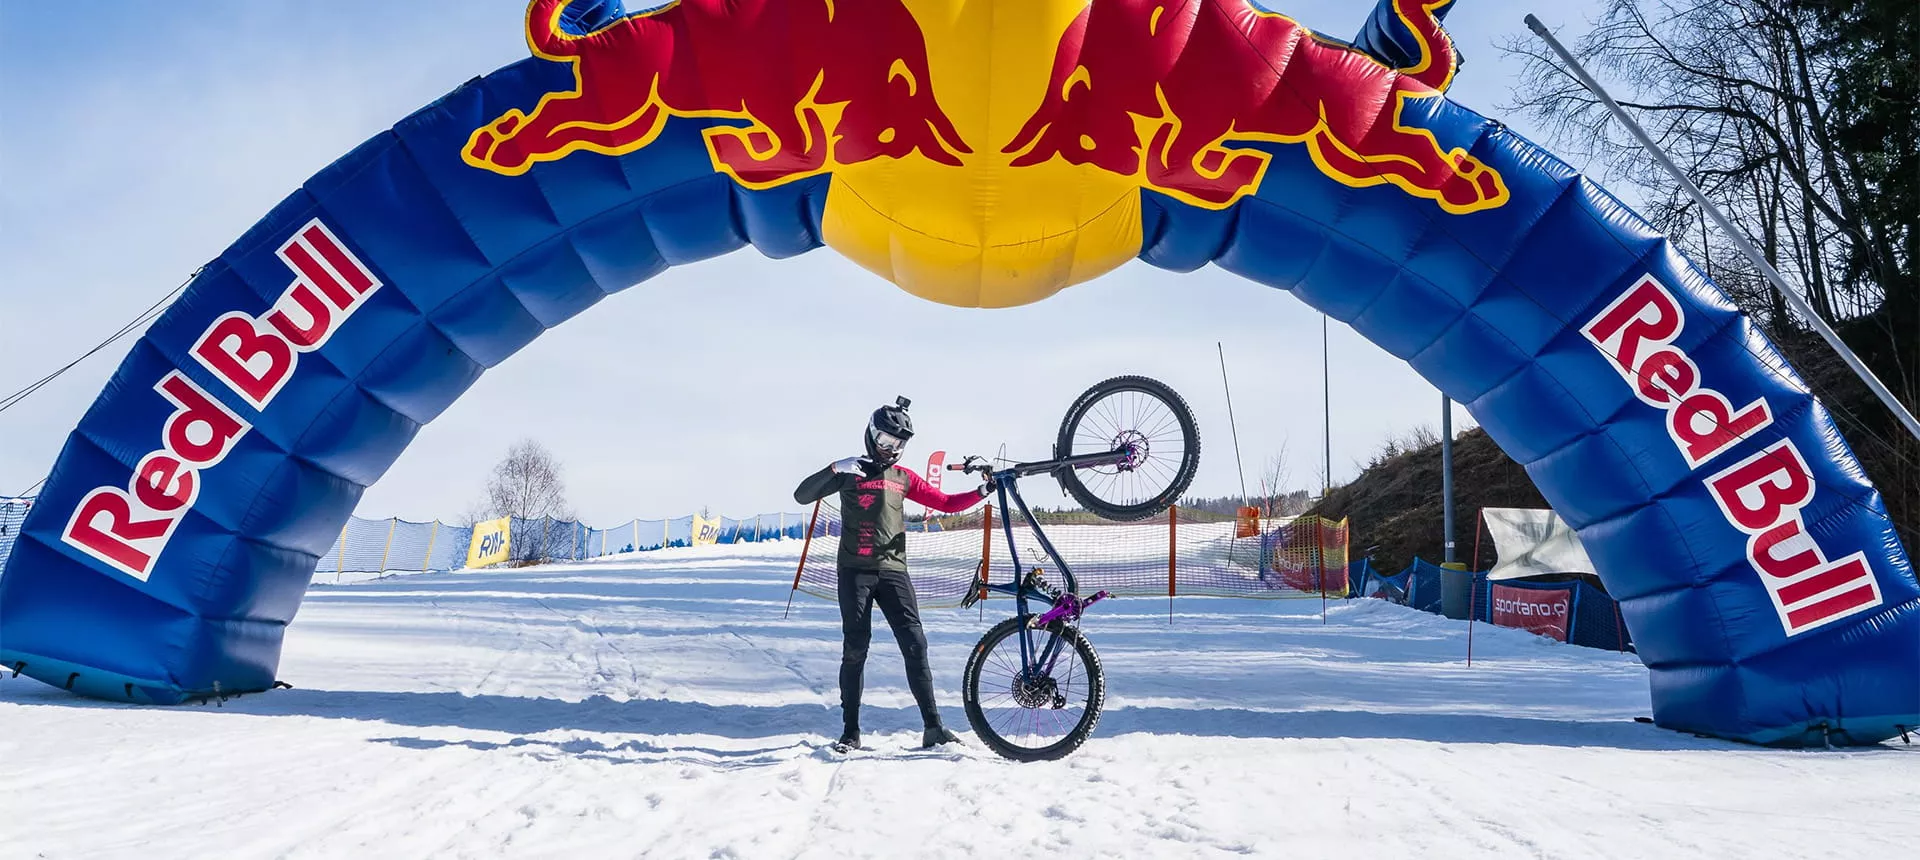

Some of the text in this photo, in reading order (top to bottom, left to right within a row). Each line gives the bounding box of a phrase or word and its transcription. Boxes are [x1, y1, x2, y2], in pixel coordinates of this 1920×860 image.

[61, 217, 384, 582] Red Bull
[1579, 272, 1883, 637] Red Bull
